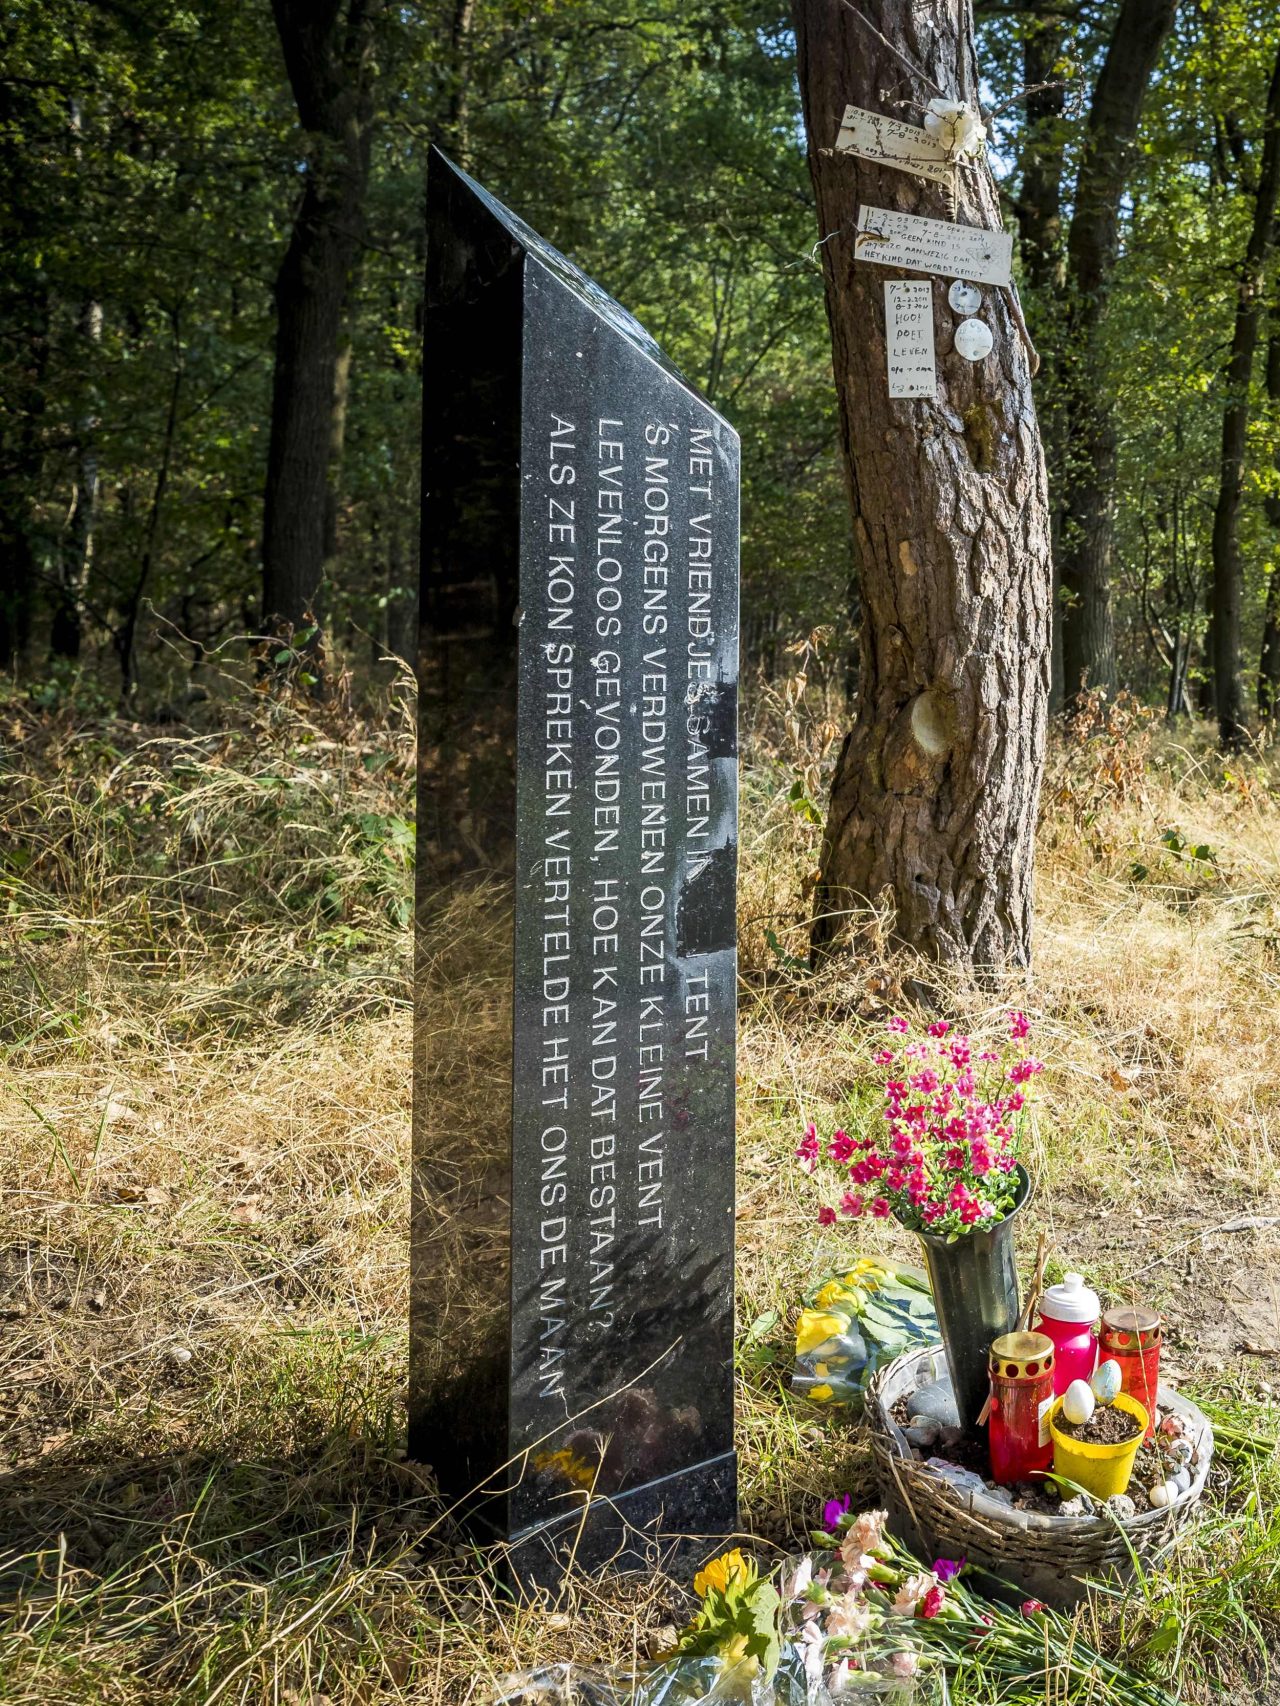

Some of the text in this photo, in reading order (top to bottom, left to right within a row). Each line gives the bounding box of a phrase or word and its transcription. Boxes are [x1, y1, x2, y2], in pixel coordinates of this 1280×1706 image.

[865, 250, 880, 258] HET
[882, 254, 903, 263] KIND
[906, 258, 922, 266] DAT
[925, 263, 952, 272] WORDT
[901, 233, 922, 243] GEEN
[893, 347, 927, 357] LEVEN
[689, 428, 712, 499] MET
[642, 456, 669, 634] MORGENS
[640, 648, 667, 874] VERDWENEN
[686, 717, 711, 837] SAMEN
[538, 413, 576, 1398] ALS ZE KON SPREKEN VERTELDE HET ONS DE MAAN
[589, 418, 623, 1328] LEVENLOOS GEVONDEN, HOE KAN DAT BESTAAN?
[640, 886, 665, 985] ONZE
[638, 995, 664, 1123] KLEINE
[684, 968, 709, 1061] TENT
[637, 1131, 663, 1229] VENT
